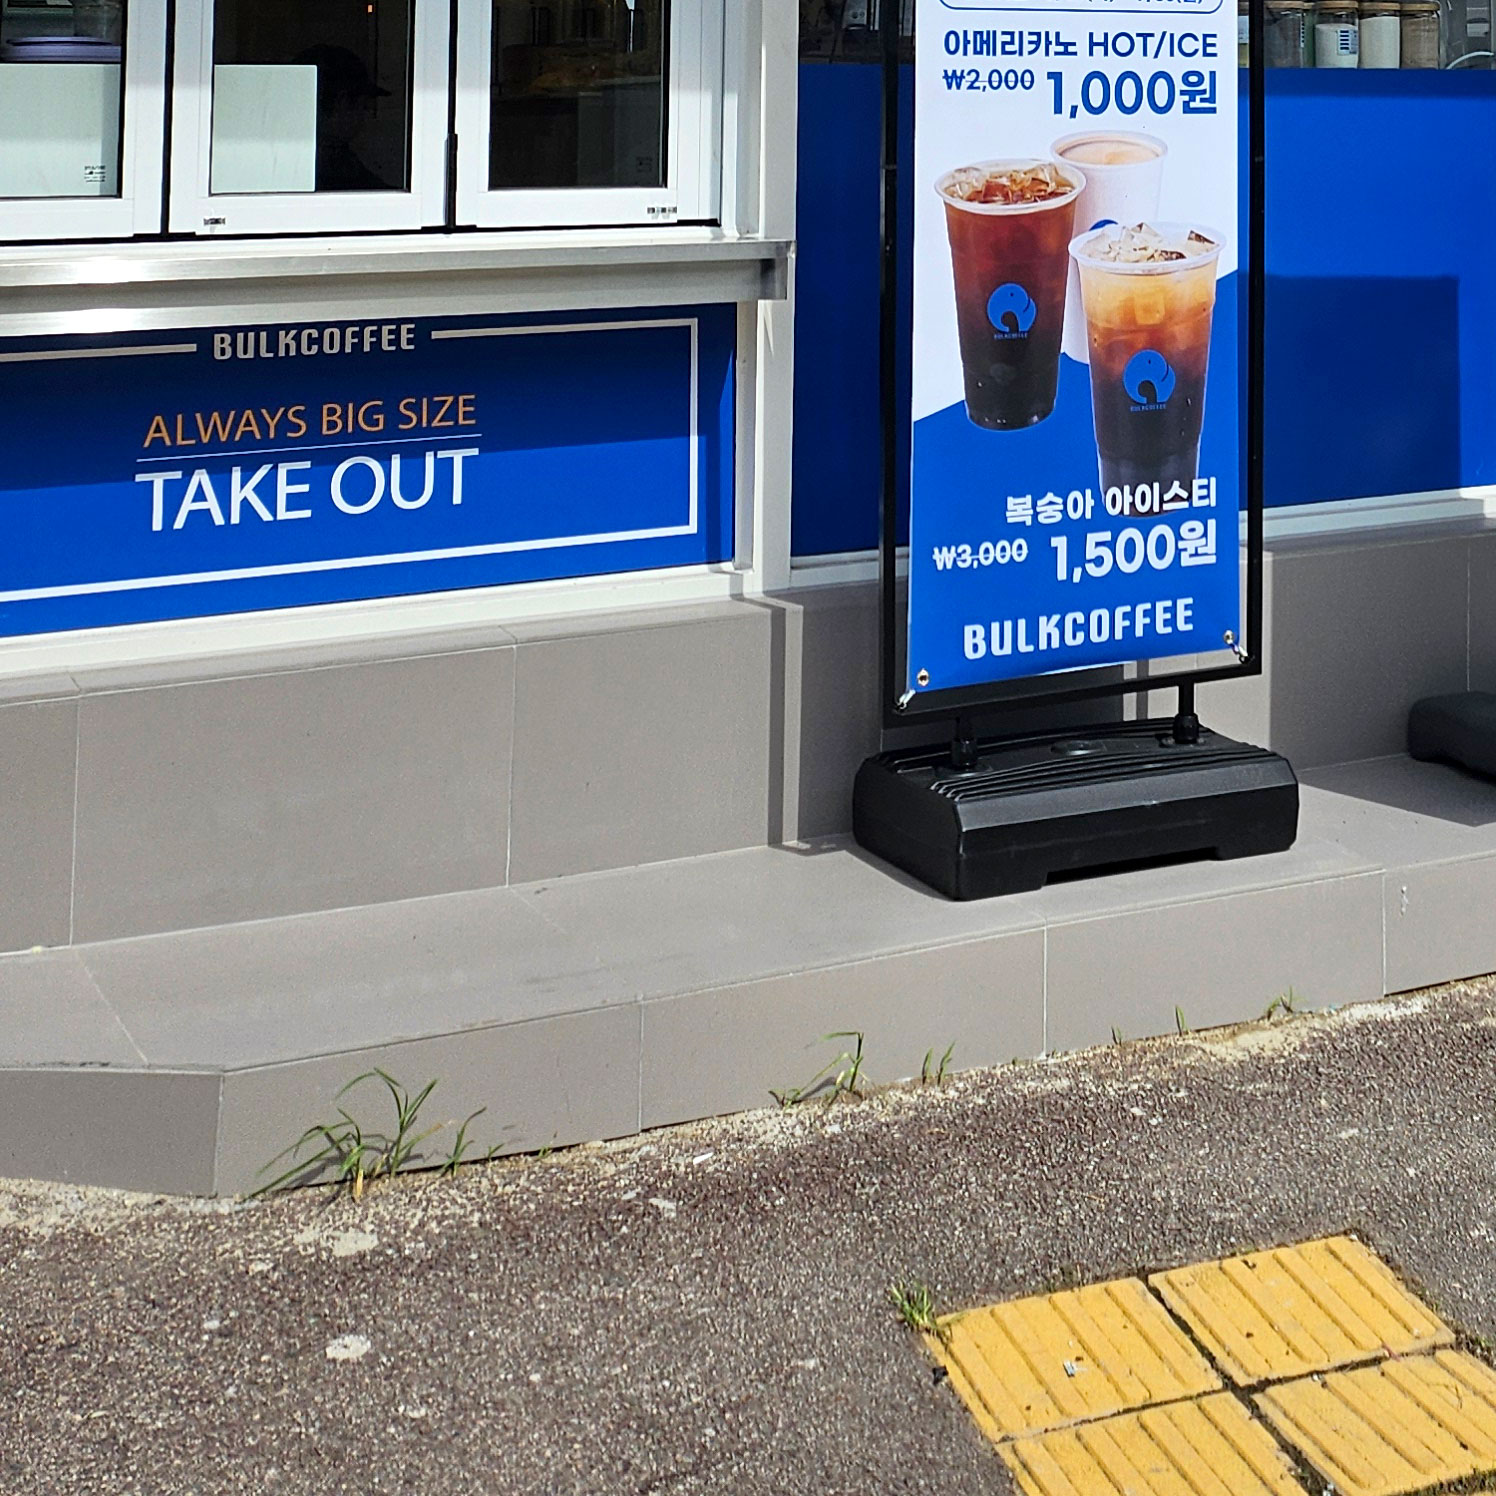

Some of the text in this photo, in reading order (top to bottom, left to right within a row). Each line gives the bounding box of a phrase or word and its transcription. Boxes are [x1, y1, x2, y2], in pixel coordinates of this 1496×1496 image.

[943, 29, 1219, 59] 아메리카노 HOT/ICE
[1046, 69, 1218, 119] 1,000원
[213, 322, 416, 360] BULKCOFFEE
[143, 393, 478, 448] ALWAYS BIG SIZE
[135, 447, 480, 532] TAKE OUT
[1005, 476, 1217, 527] 복숭아 아이스티
[1049, 518, 1217, 583] 1,500원
[963, 597, 1194, 660] BULKCOFFEE
